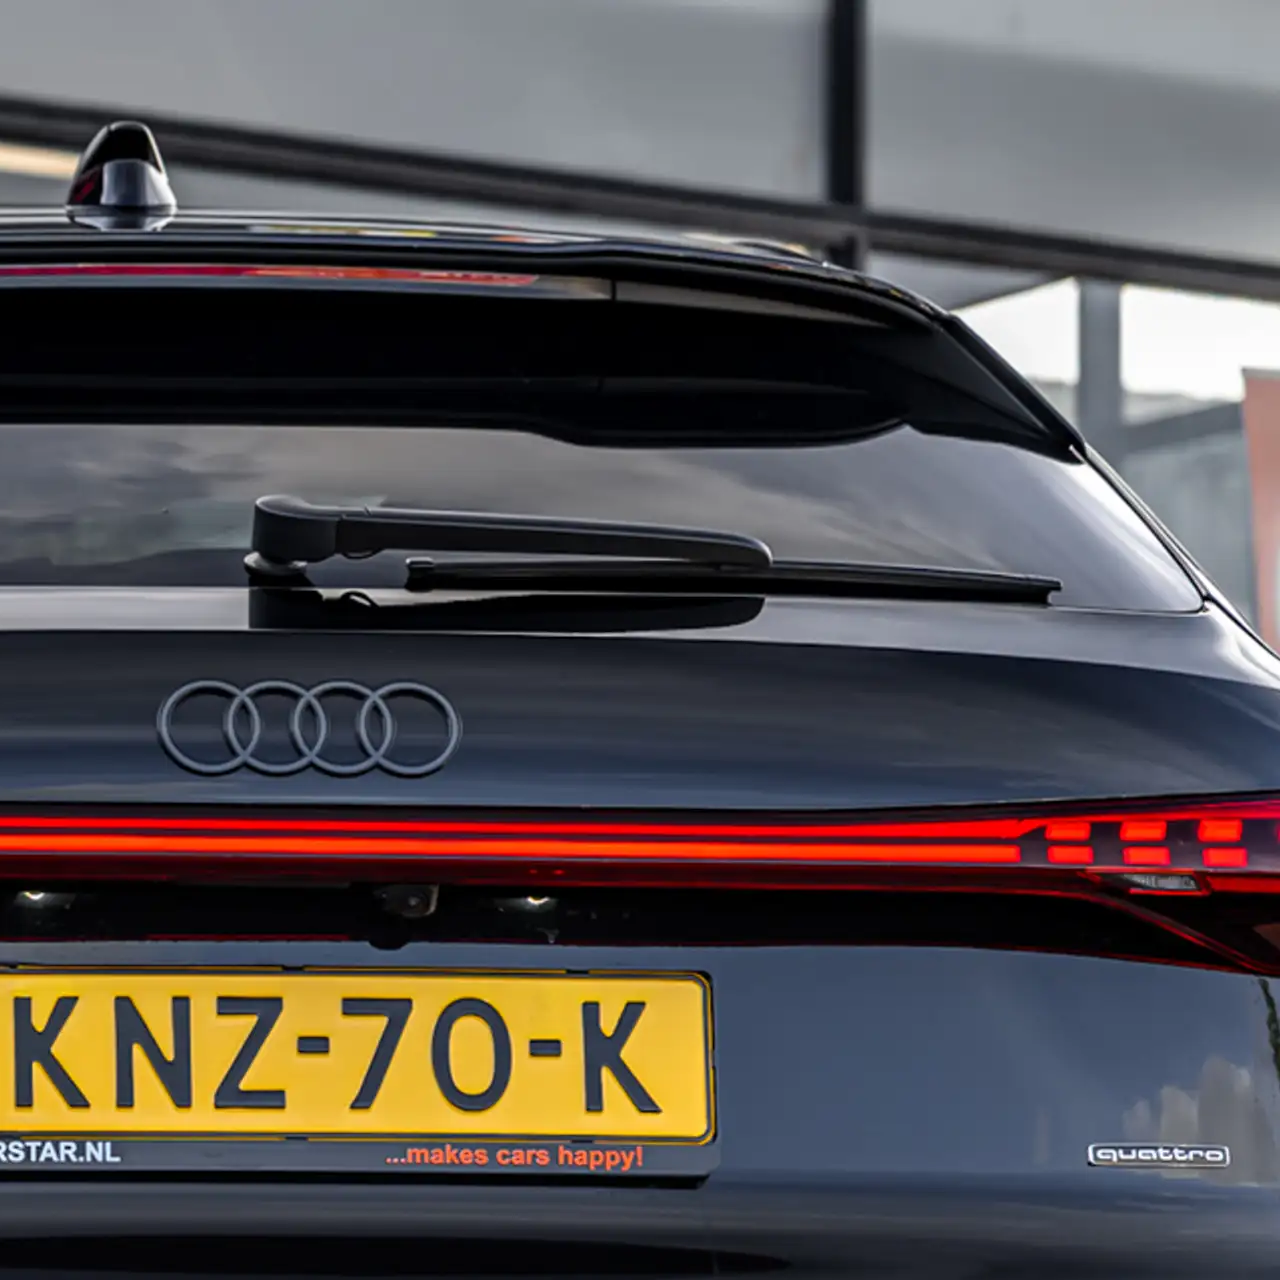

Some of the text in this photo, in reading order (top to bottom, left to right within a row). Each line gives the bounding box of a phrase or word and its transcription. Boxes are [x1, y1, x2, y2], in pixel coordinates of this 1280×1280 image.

[13, 996, 662, 1113] KNZ-70-K
[385, 1144, 644, 1171] ...makes cars happy!
[1096, 1147, 1225, 1162] quattro
